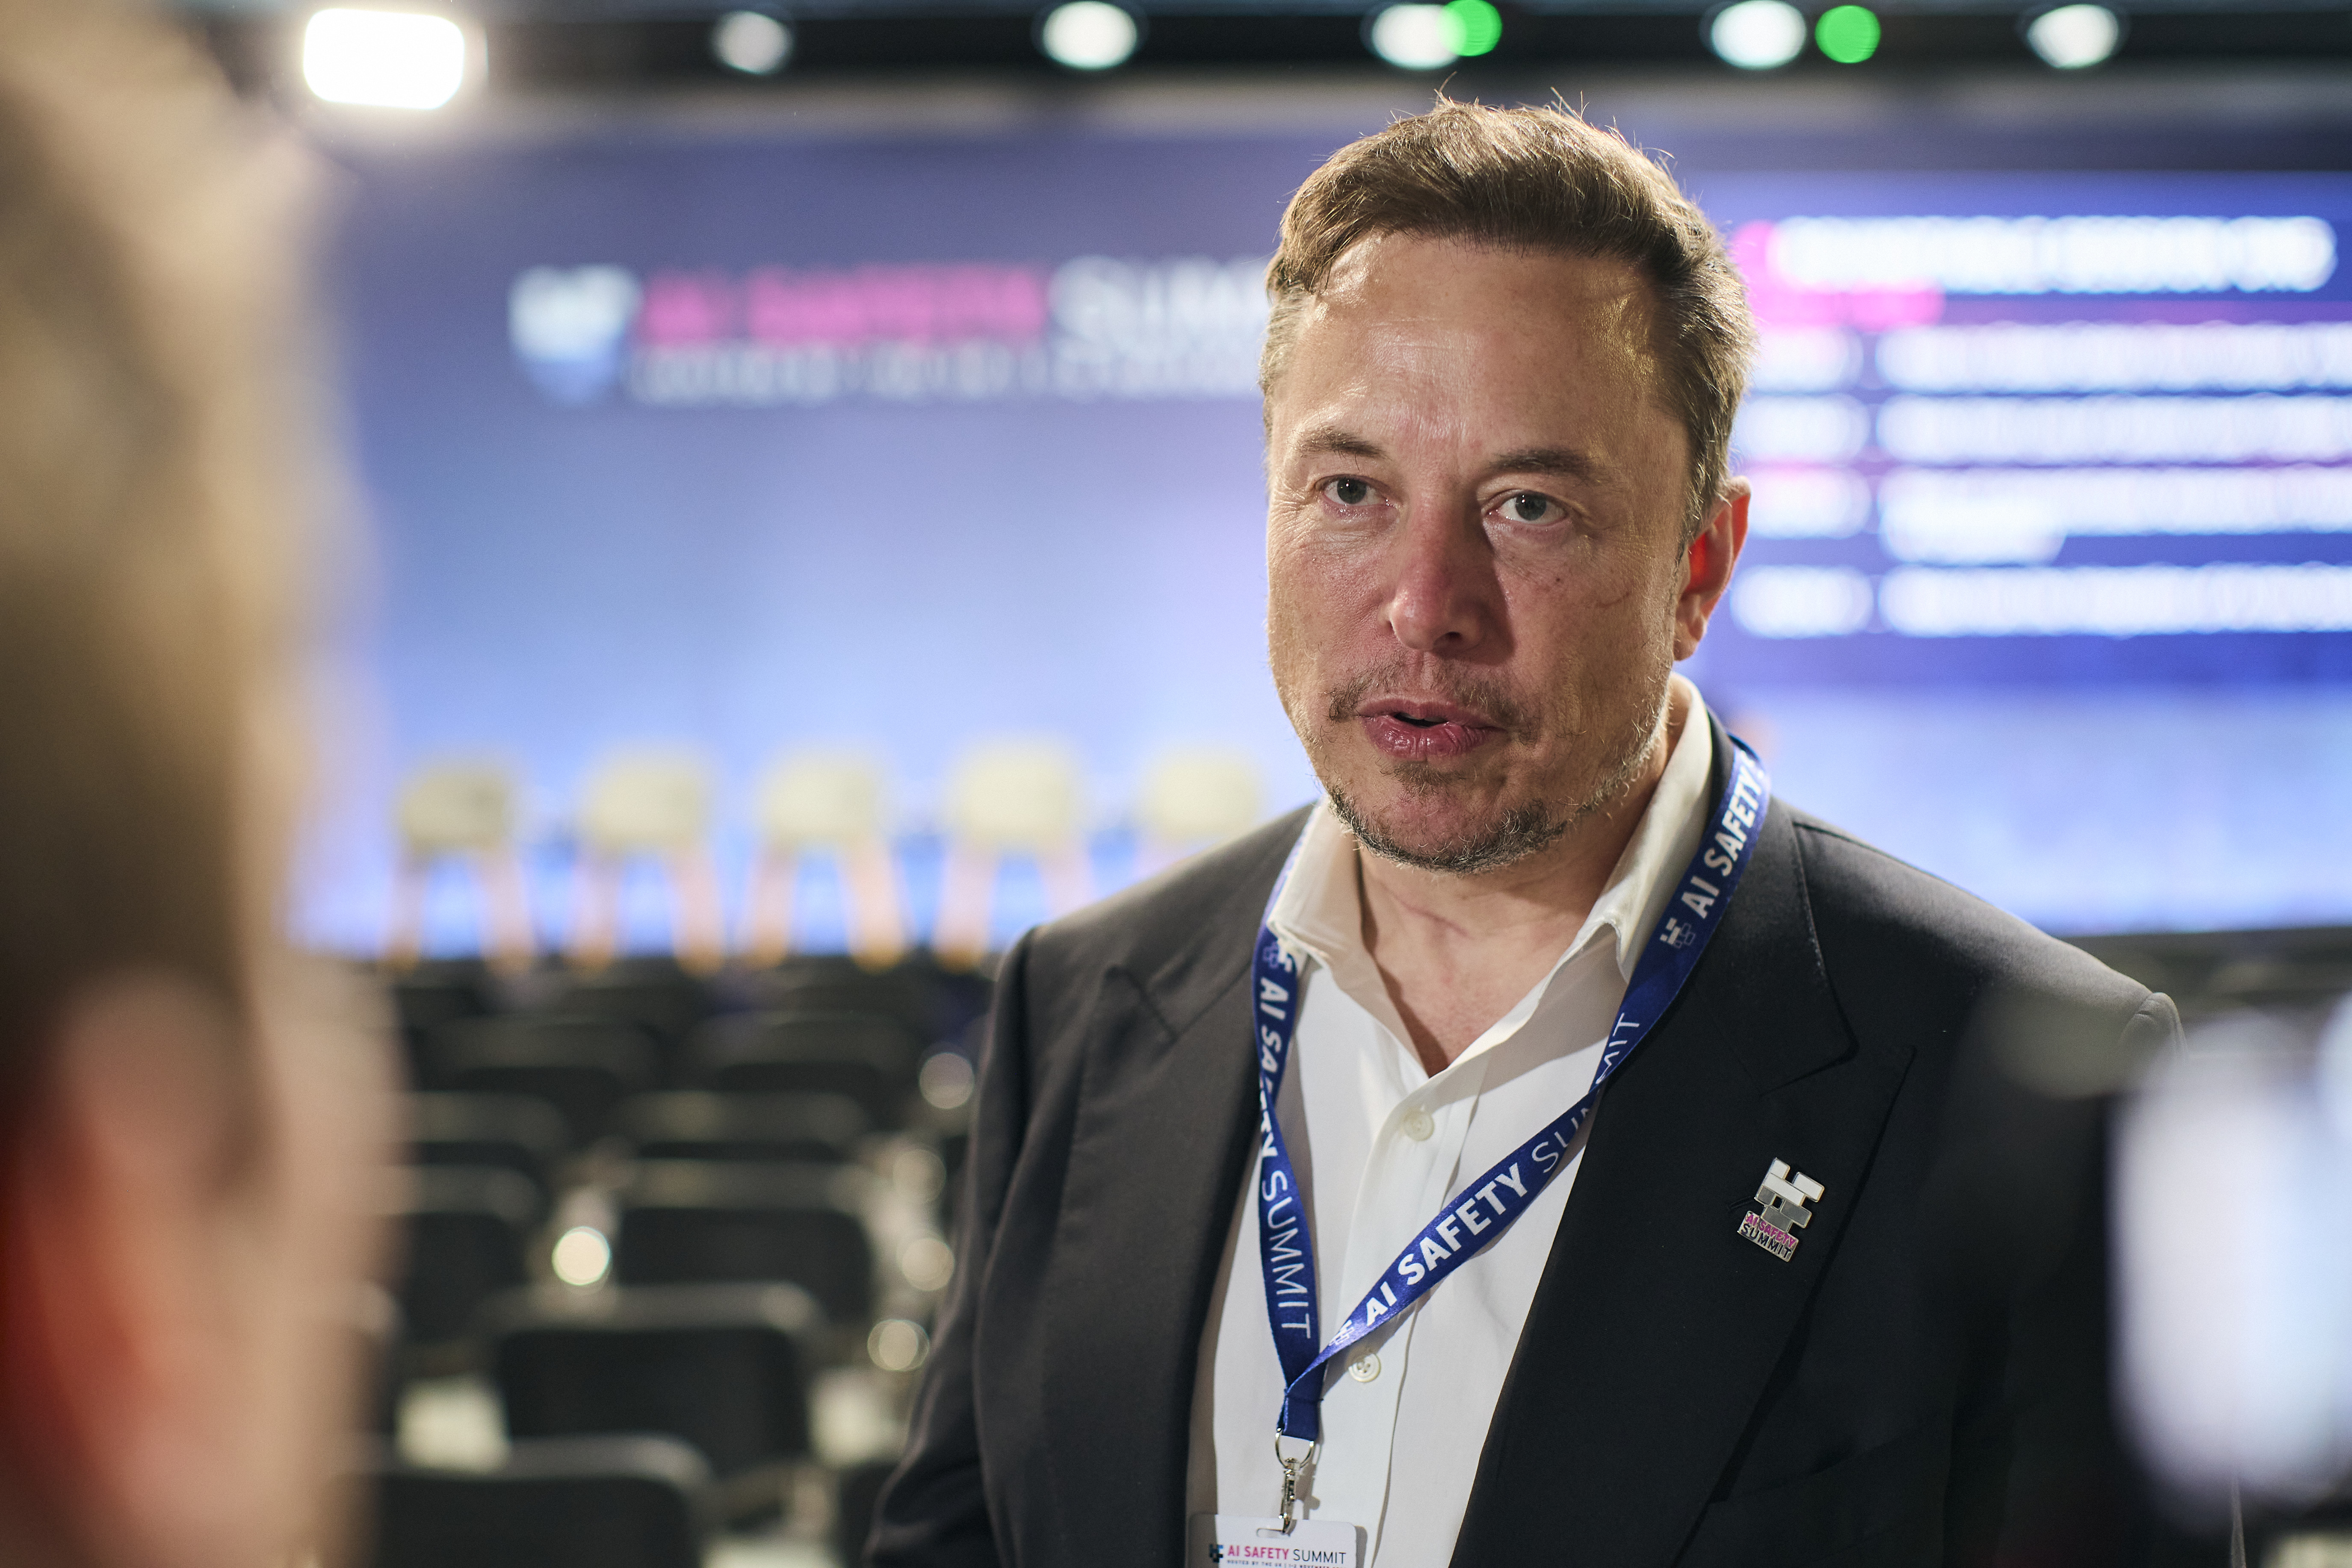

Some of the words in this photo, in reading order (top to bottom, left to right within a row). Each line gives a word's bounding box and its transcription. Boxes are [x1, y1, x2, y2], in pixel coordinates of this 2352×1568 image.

[1680, 875, 1720, 920] AI
[1703, 765, 1762, 877] SAFETY
[1260, 977, 1289, 1021] AI
[1365, 1281, 1398, 1327] AI
[1398, 1162, 1528, 1287] SAFETY
[1741, 1223, 1792, 1258] SUMMIT
[1745, 1214, 1758, 1226] AI
[1758, 1221, 1796, 1248] SAFETY
[1262, 1169, 1312, 1339] SUMMIT
[1227, 1545, 1240, 1556] AI
[1244, 1546, 1289, 1560] SAFETY
[1293, 1549, 1346, 1564] SUMMIT
